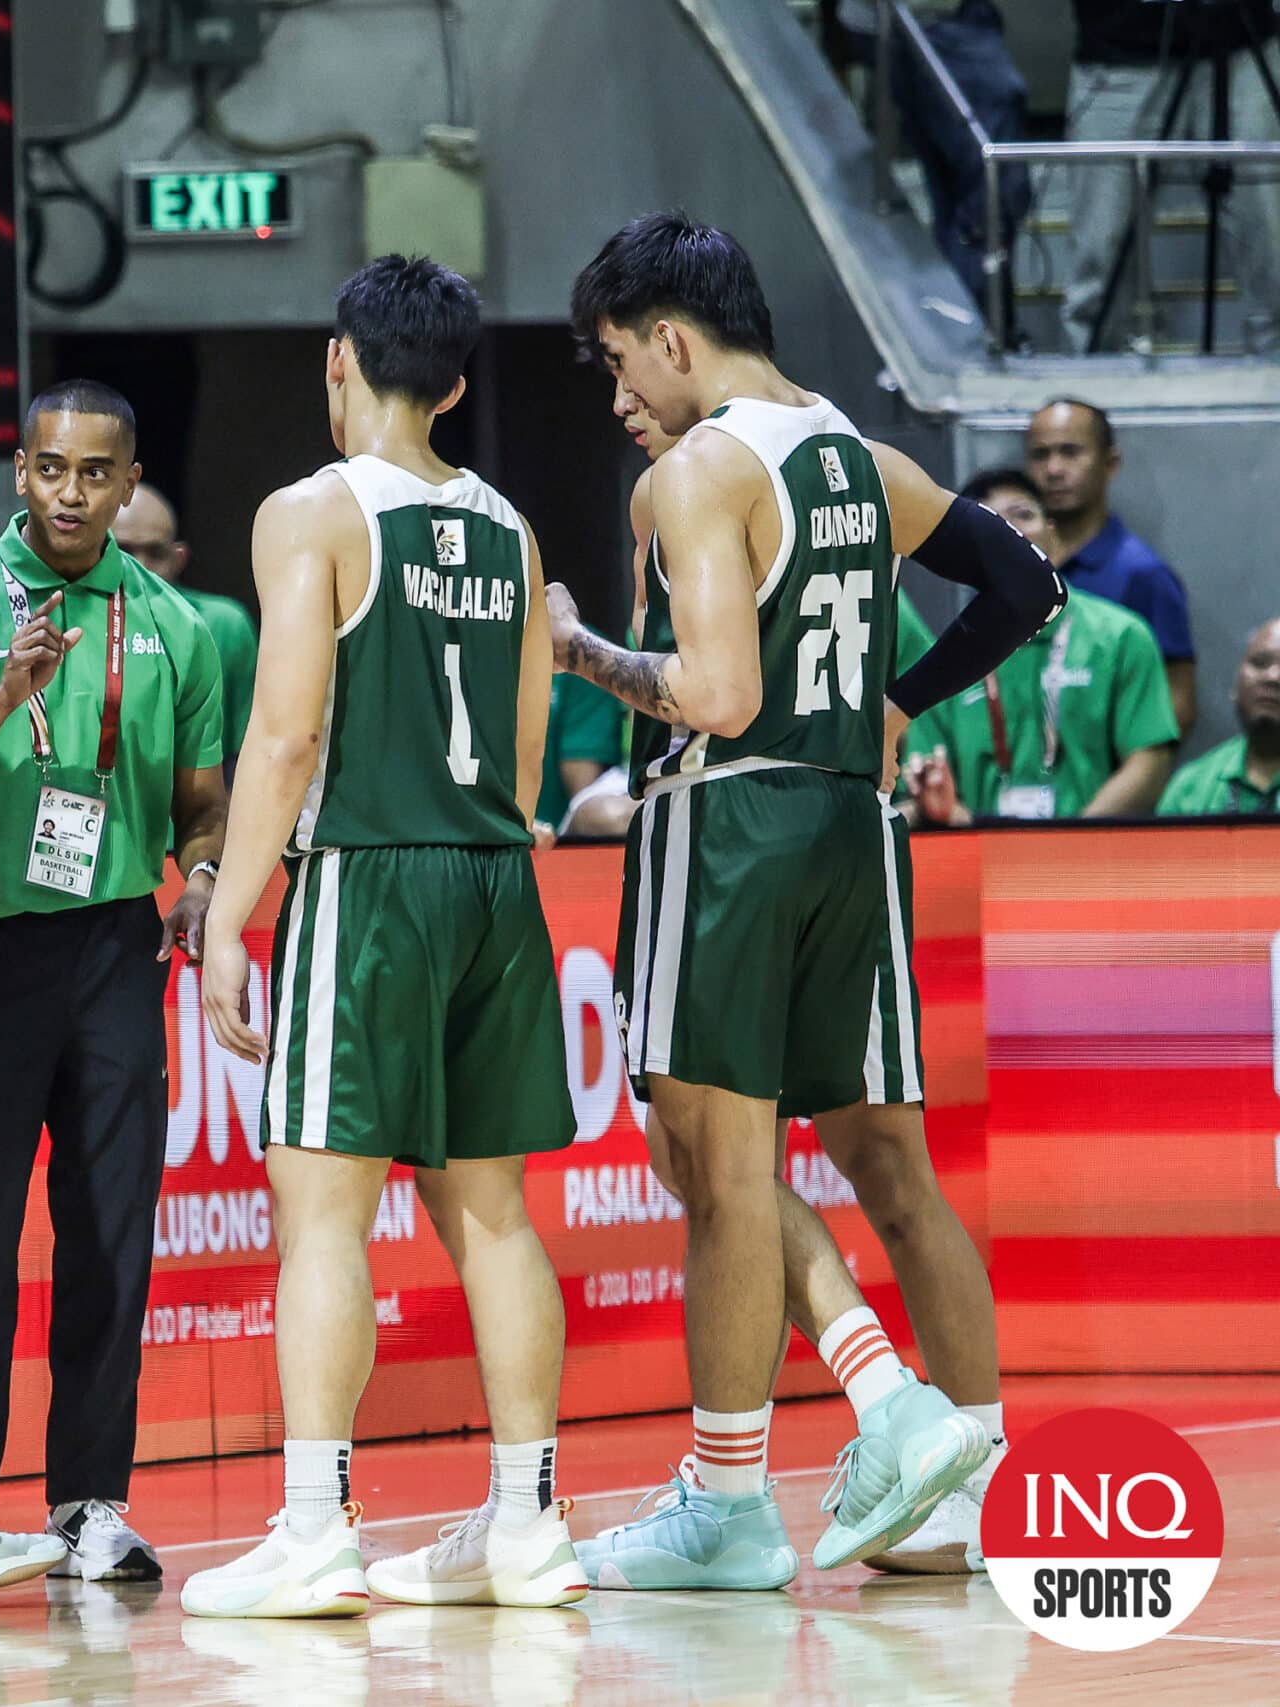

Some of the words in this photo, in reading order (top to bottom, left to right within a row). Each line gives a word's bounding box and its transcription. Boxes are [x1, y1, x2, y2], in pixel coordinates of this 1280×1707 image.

[150, 171, 276, 232] EXIT
[444, 643, 480, 785] 1
[85, 818, 96, 833] C
[39, 858, 84, 877] BASKETBALL
